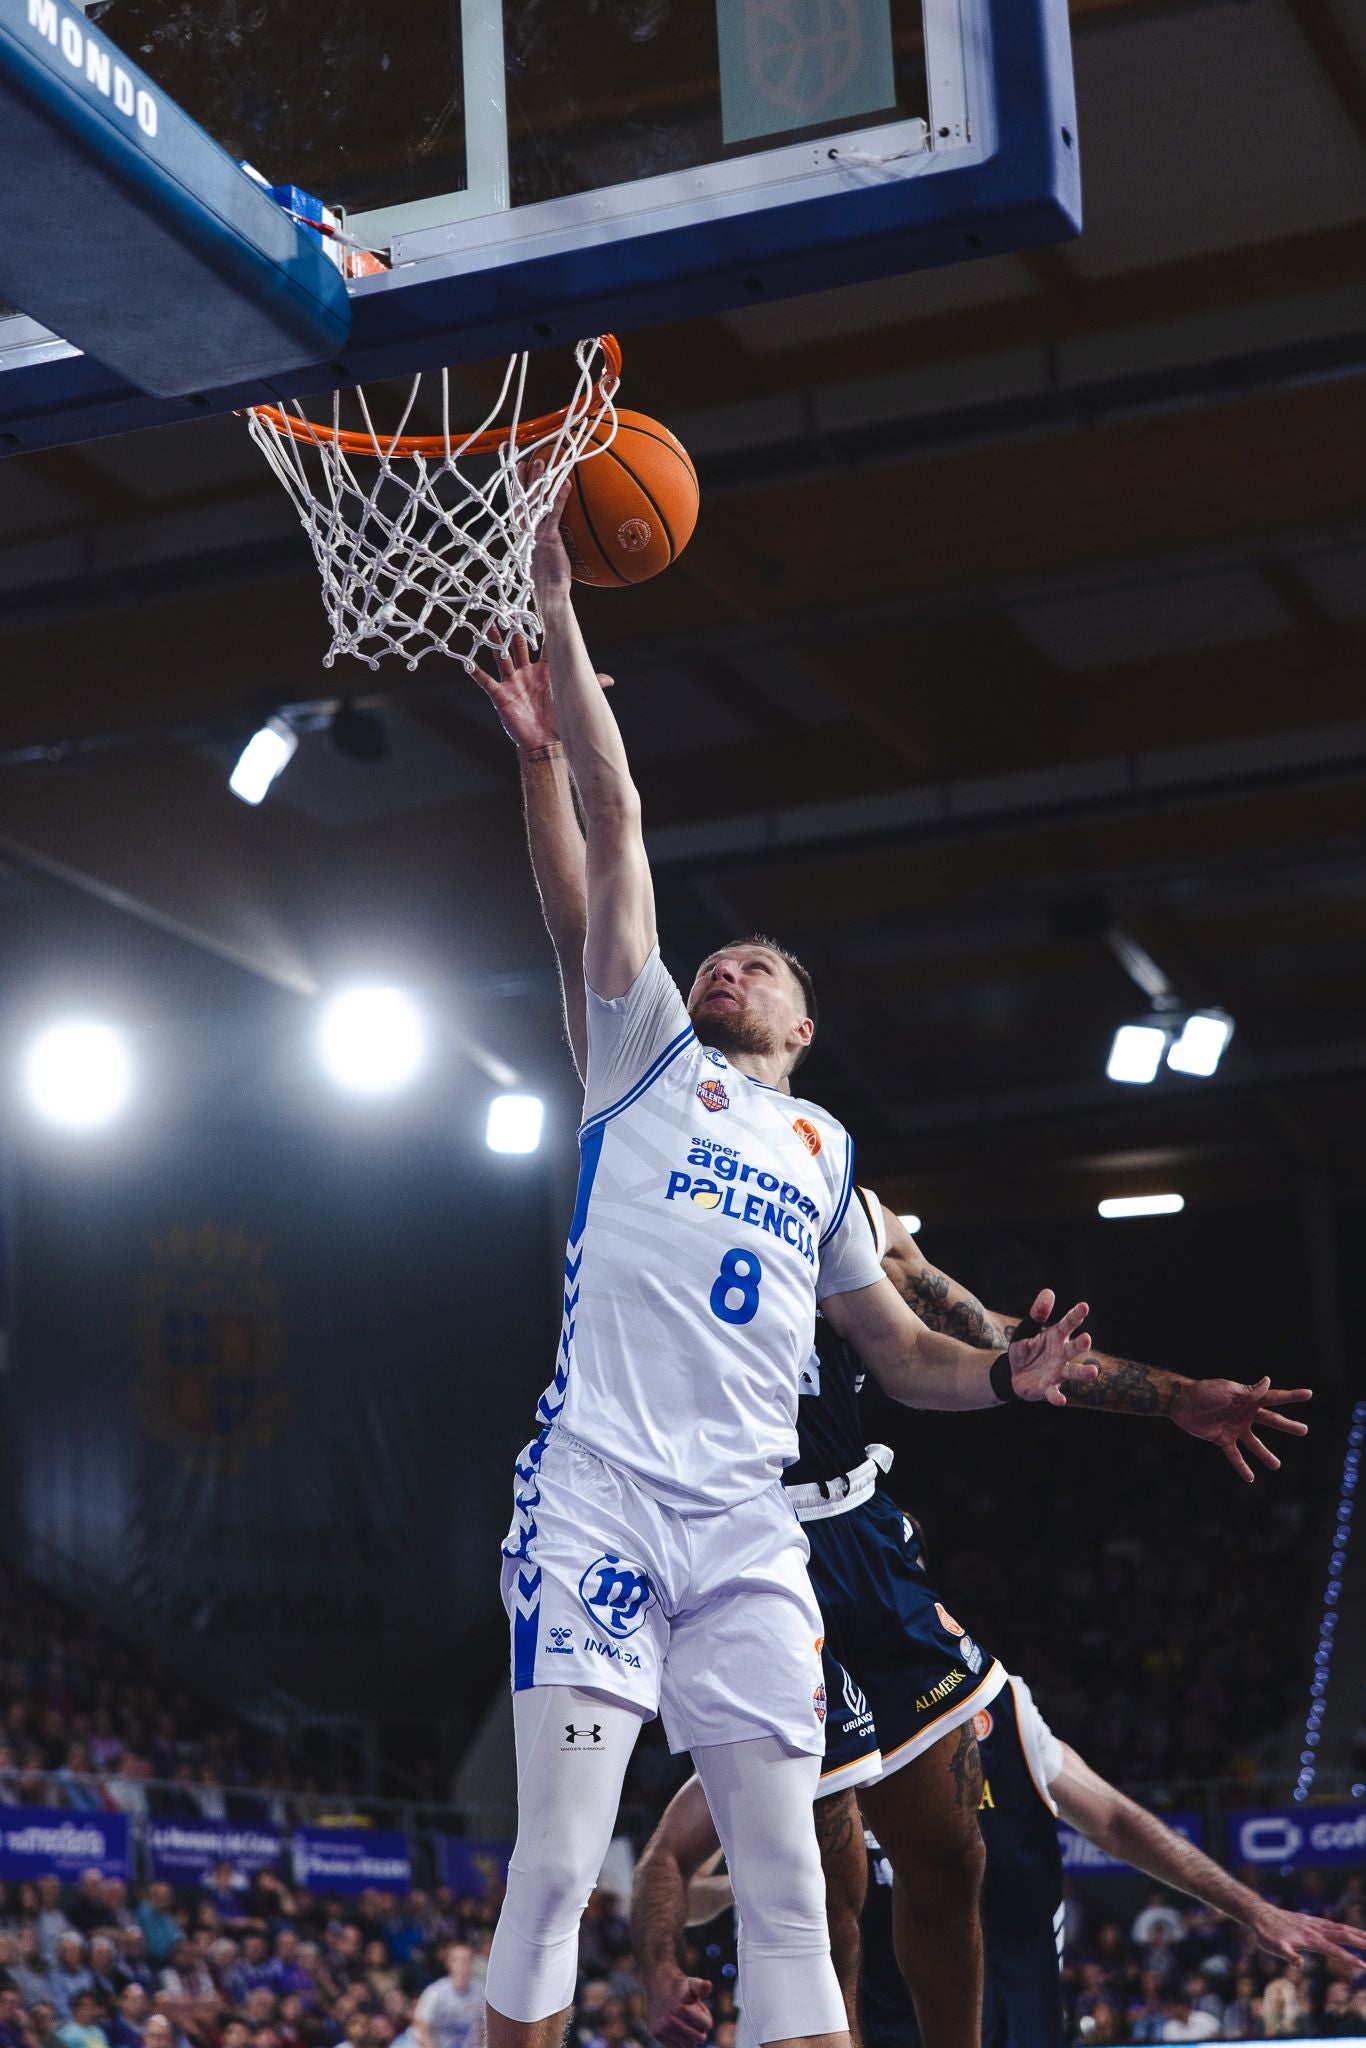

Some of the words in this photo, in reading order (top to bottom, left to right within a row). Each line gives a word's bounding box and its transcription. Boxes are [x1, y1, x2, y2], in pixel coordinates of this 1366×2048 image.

[28, 0, 157, 138] MONDO
[697, 1085, 728, 1108] PALENCIA
[691, 1137, 741, 1158] súper
[709, 1247, 762, 1325] 8
[545, 1645, 574, 1655] hummel
